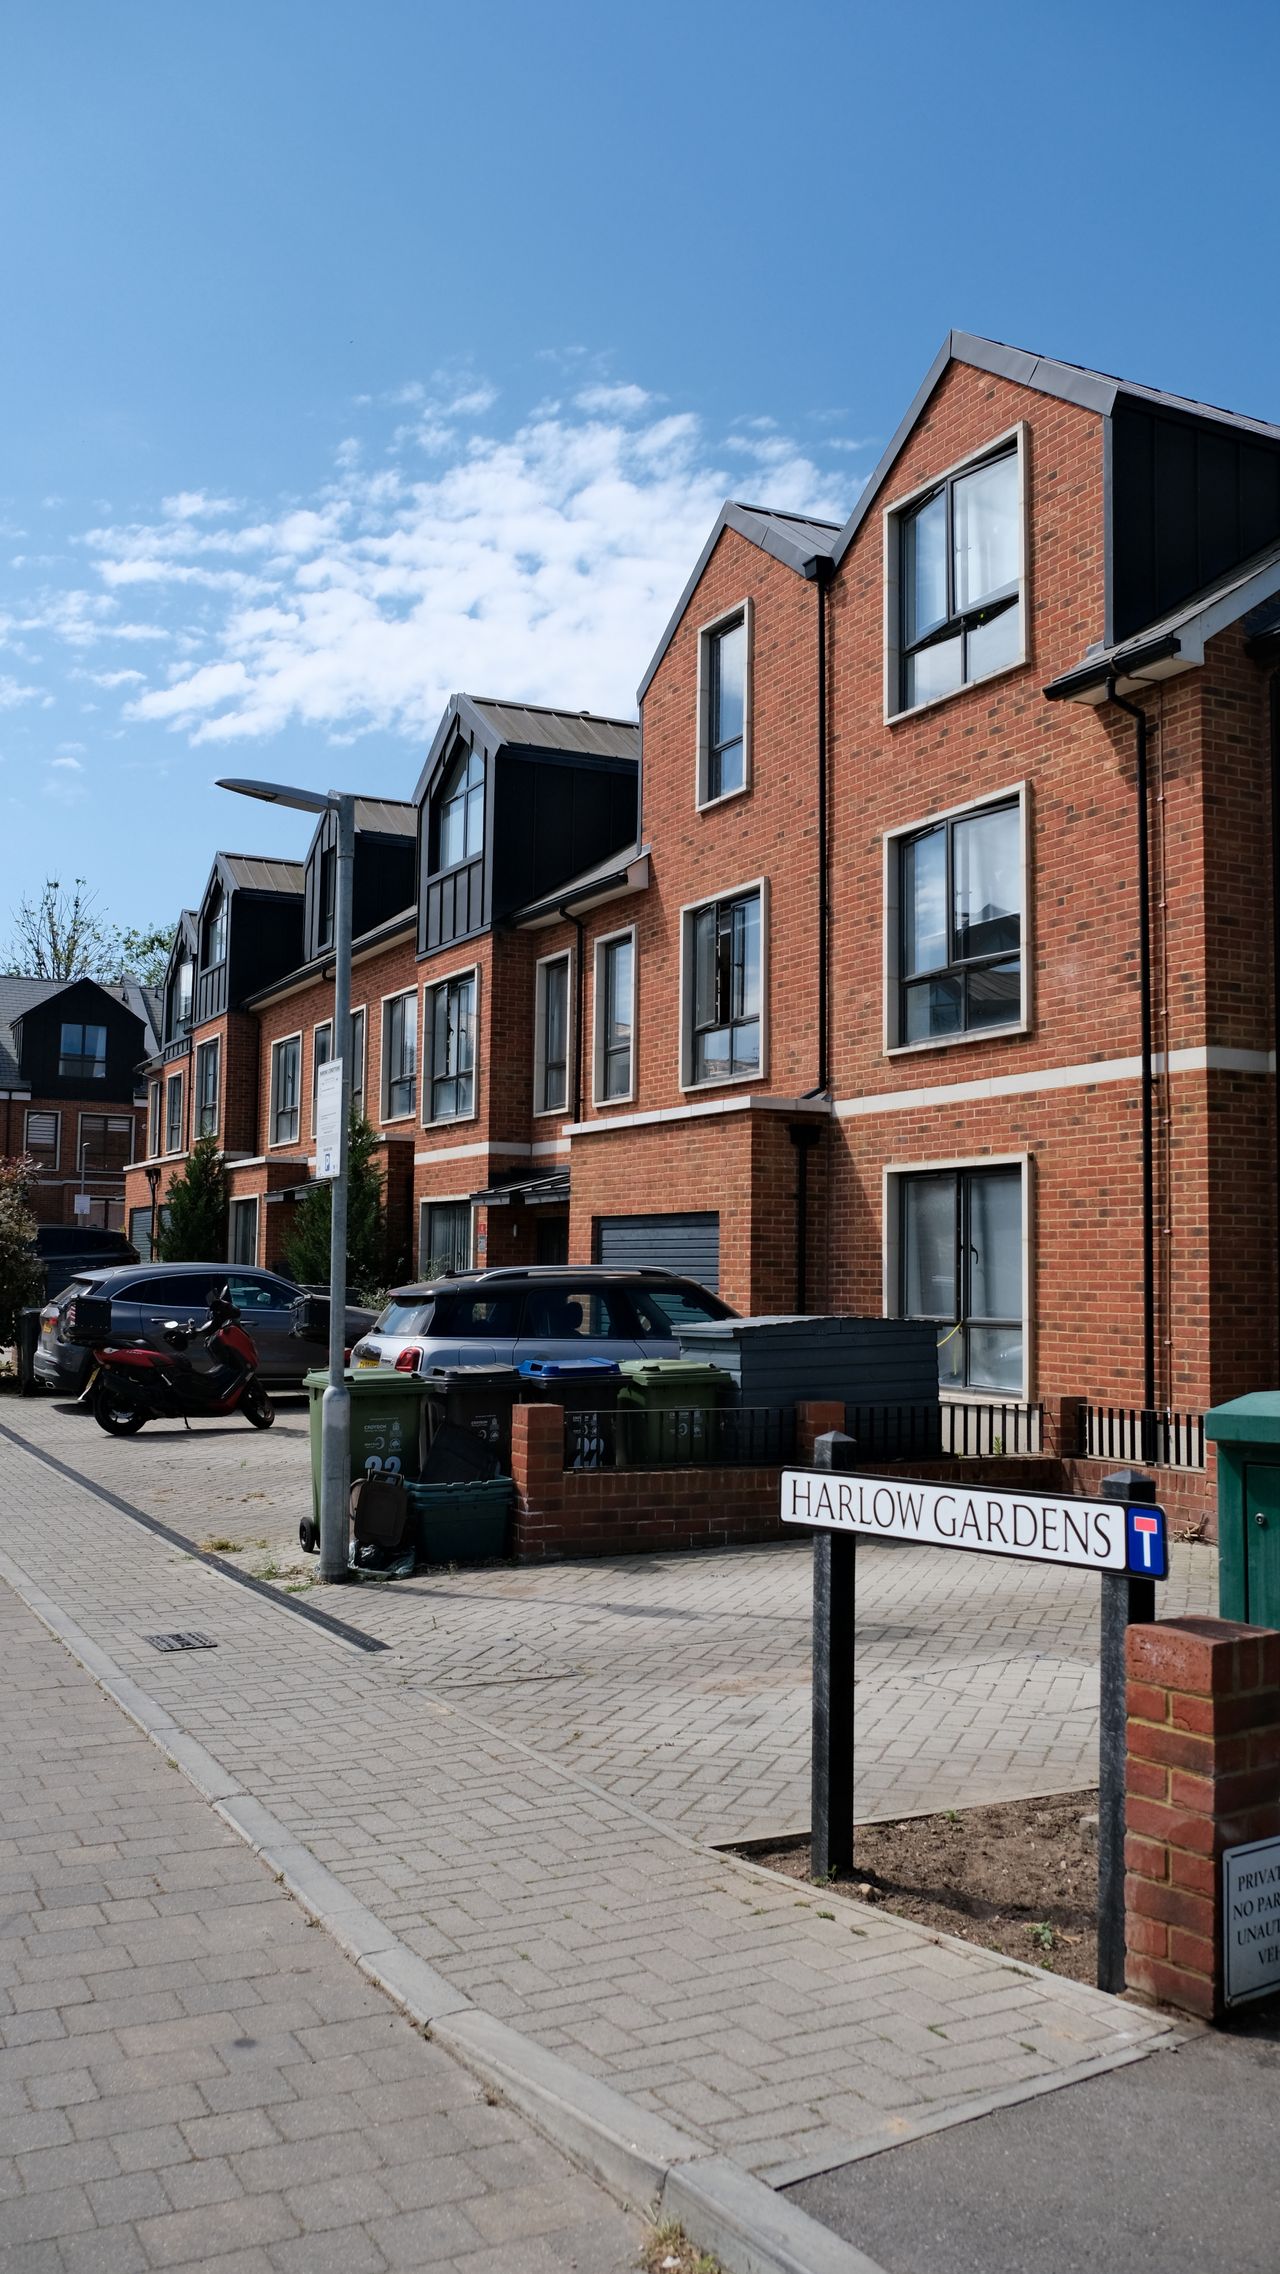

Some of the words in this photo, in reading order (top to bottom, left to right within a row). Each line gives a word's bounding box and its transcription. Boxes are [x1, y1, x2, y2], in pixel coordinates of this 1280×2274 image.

[791, 1478, 925, 1531] HARLOW
[933, 1495, 1112, 1558] GARDENS
[1233, 1900, 1254, 1920] NO
